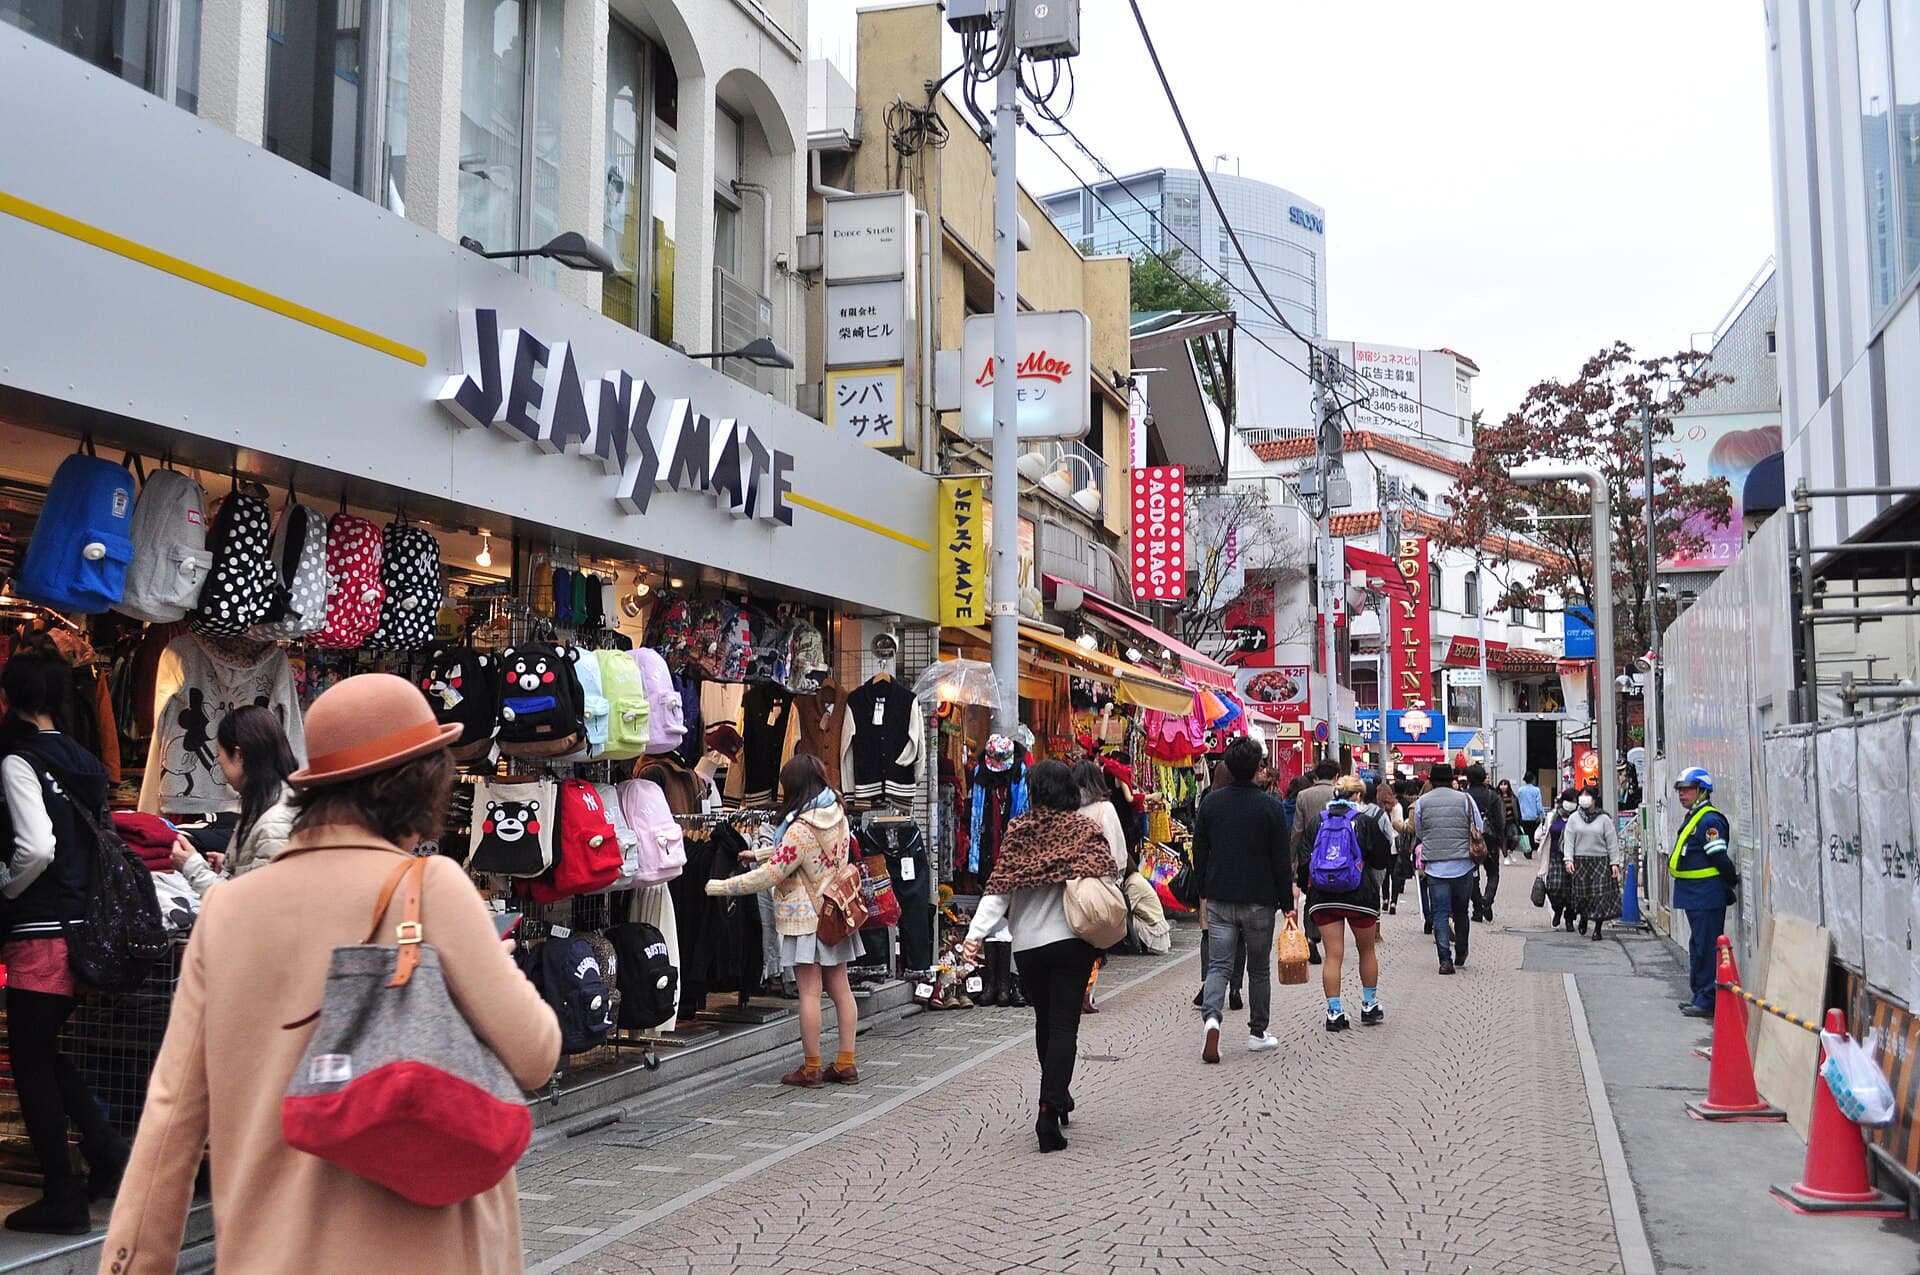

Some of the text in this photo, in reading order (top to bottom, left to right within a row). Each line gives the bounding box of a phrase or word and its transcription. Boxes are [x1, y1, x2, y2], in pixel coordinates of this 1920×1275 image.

[838, 323, 894, 340] 柴崎ビル
[840, 306, 877, 318] 有限会社
[438, 308, 795, 527] JEANS MATE
[949, 488, 974, 618] JEANS MATE
[1149, 479, 1167, 587] ACDC RAG
